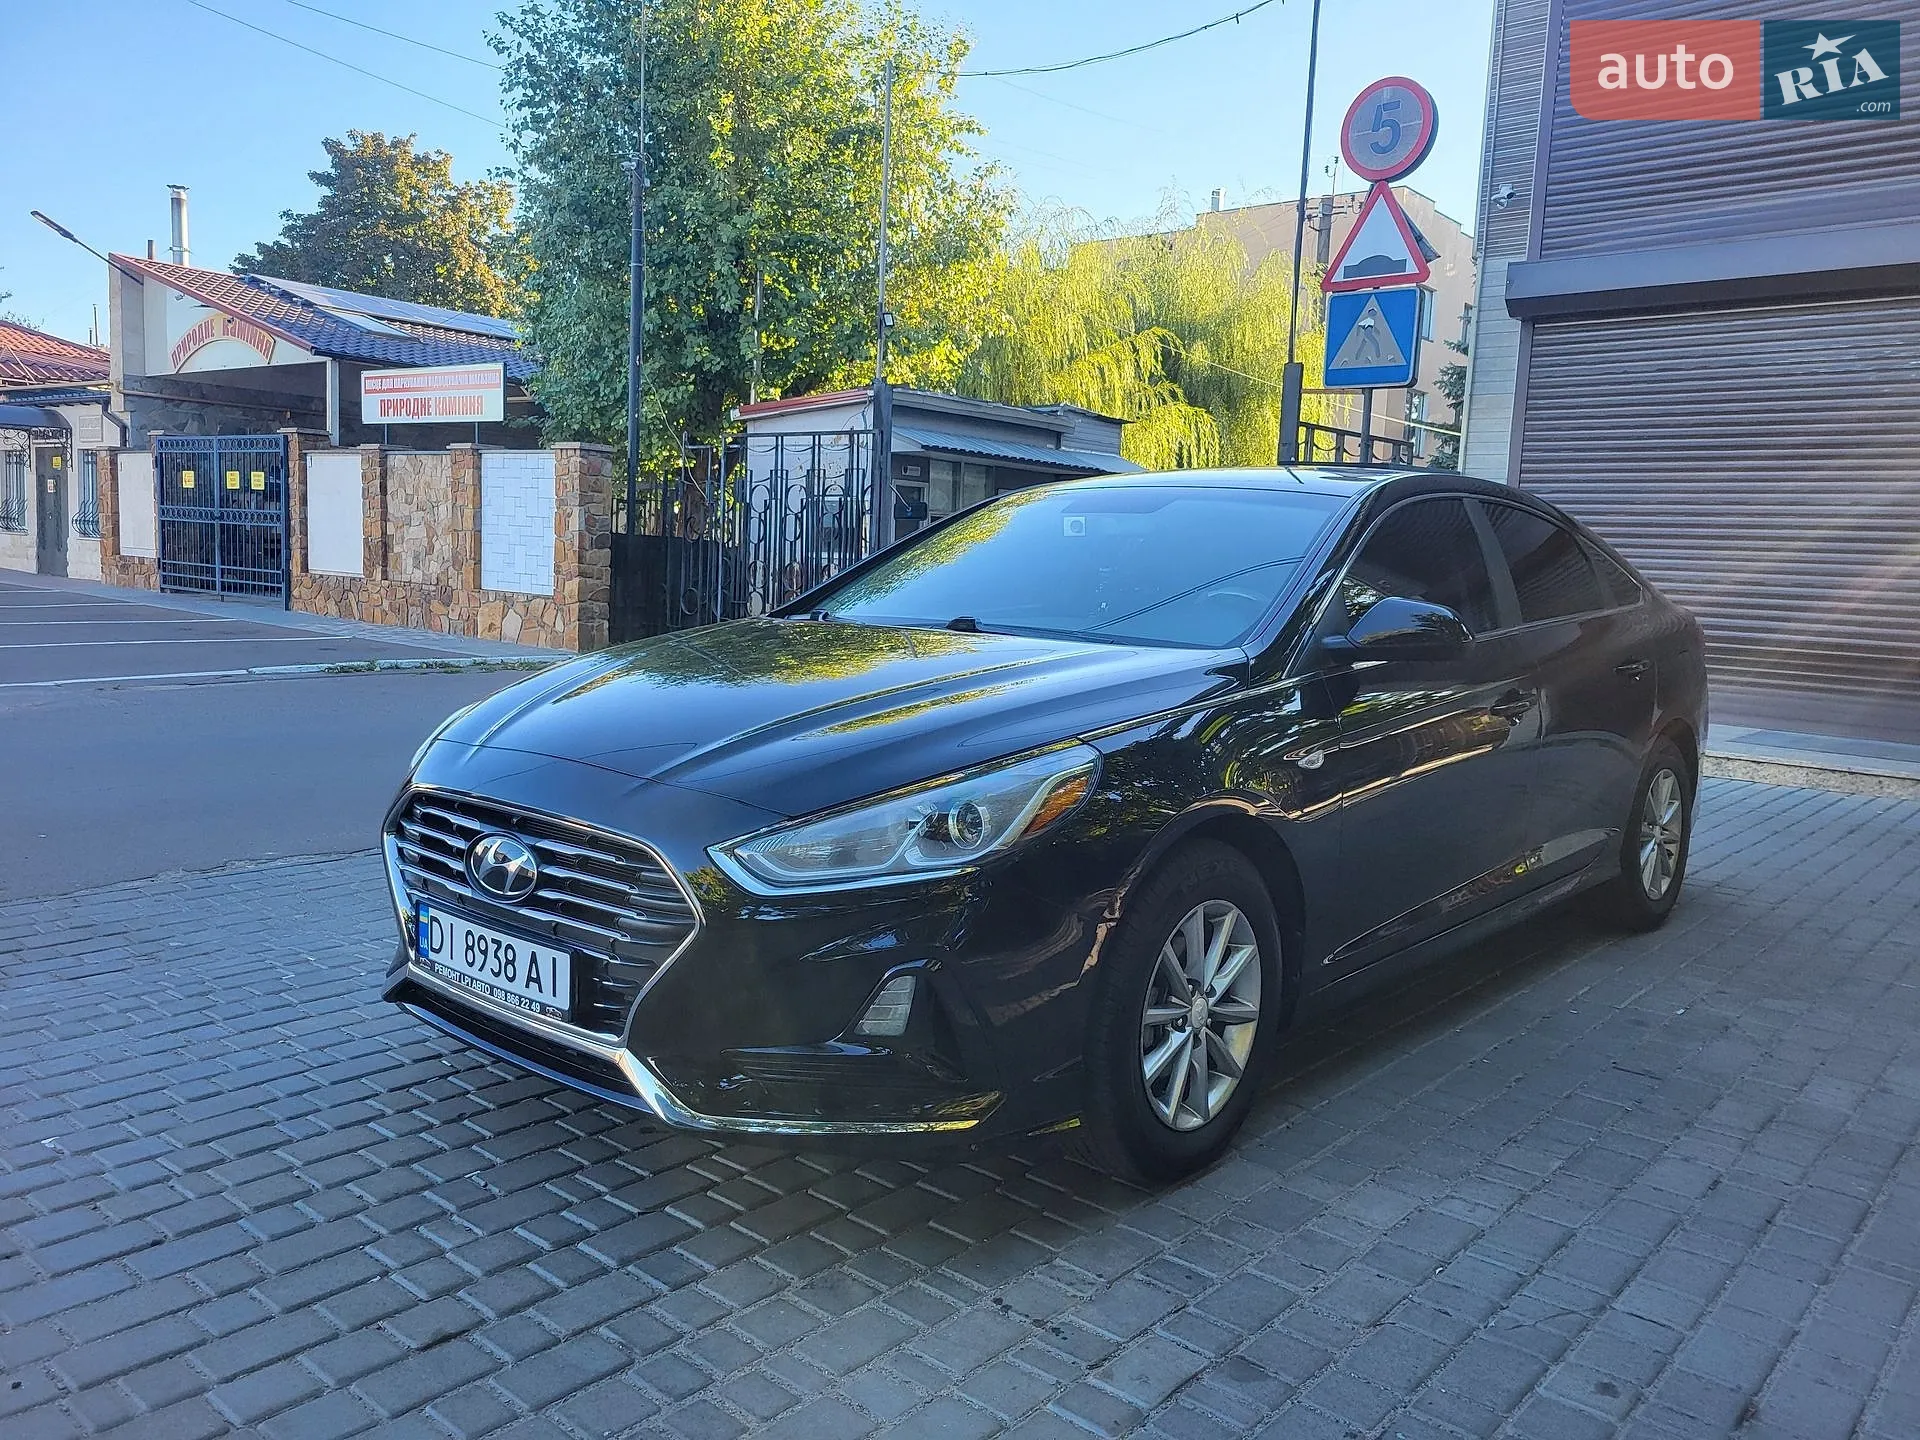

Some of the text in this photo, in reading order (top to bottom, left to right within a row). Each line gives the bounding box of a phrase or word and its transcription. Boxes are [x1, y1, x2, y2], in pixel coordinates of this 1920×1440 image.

[1369, 100, 1401, 154] 5
[171, 318, 216, 369] ПРИРОДНЕ
[380, 398, 432, 419] ПРИРОДНЕ
[419, 935, 428, 950] UA
[429, 915, 557, 998] DI 8938 AI
[434, 963, 460, 982] РЕМОНТ
[520, 998, 530, 1010] 22
[531, 1001, 541, 1013] 49
